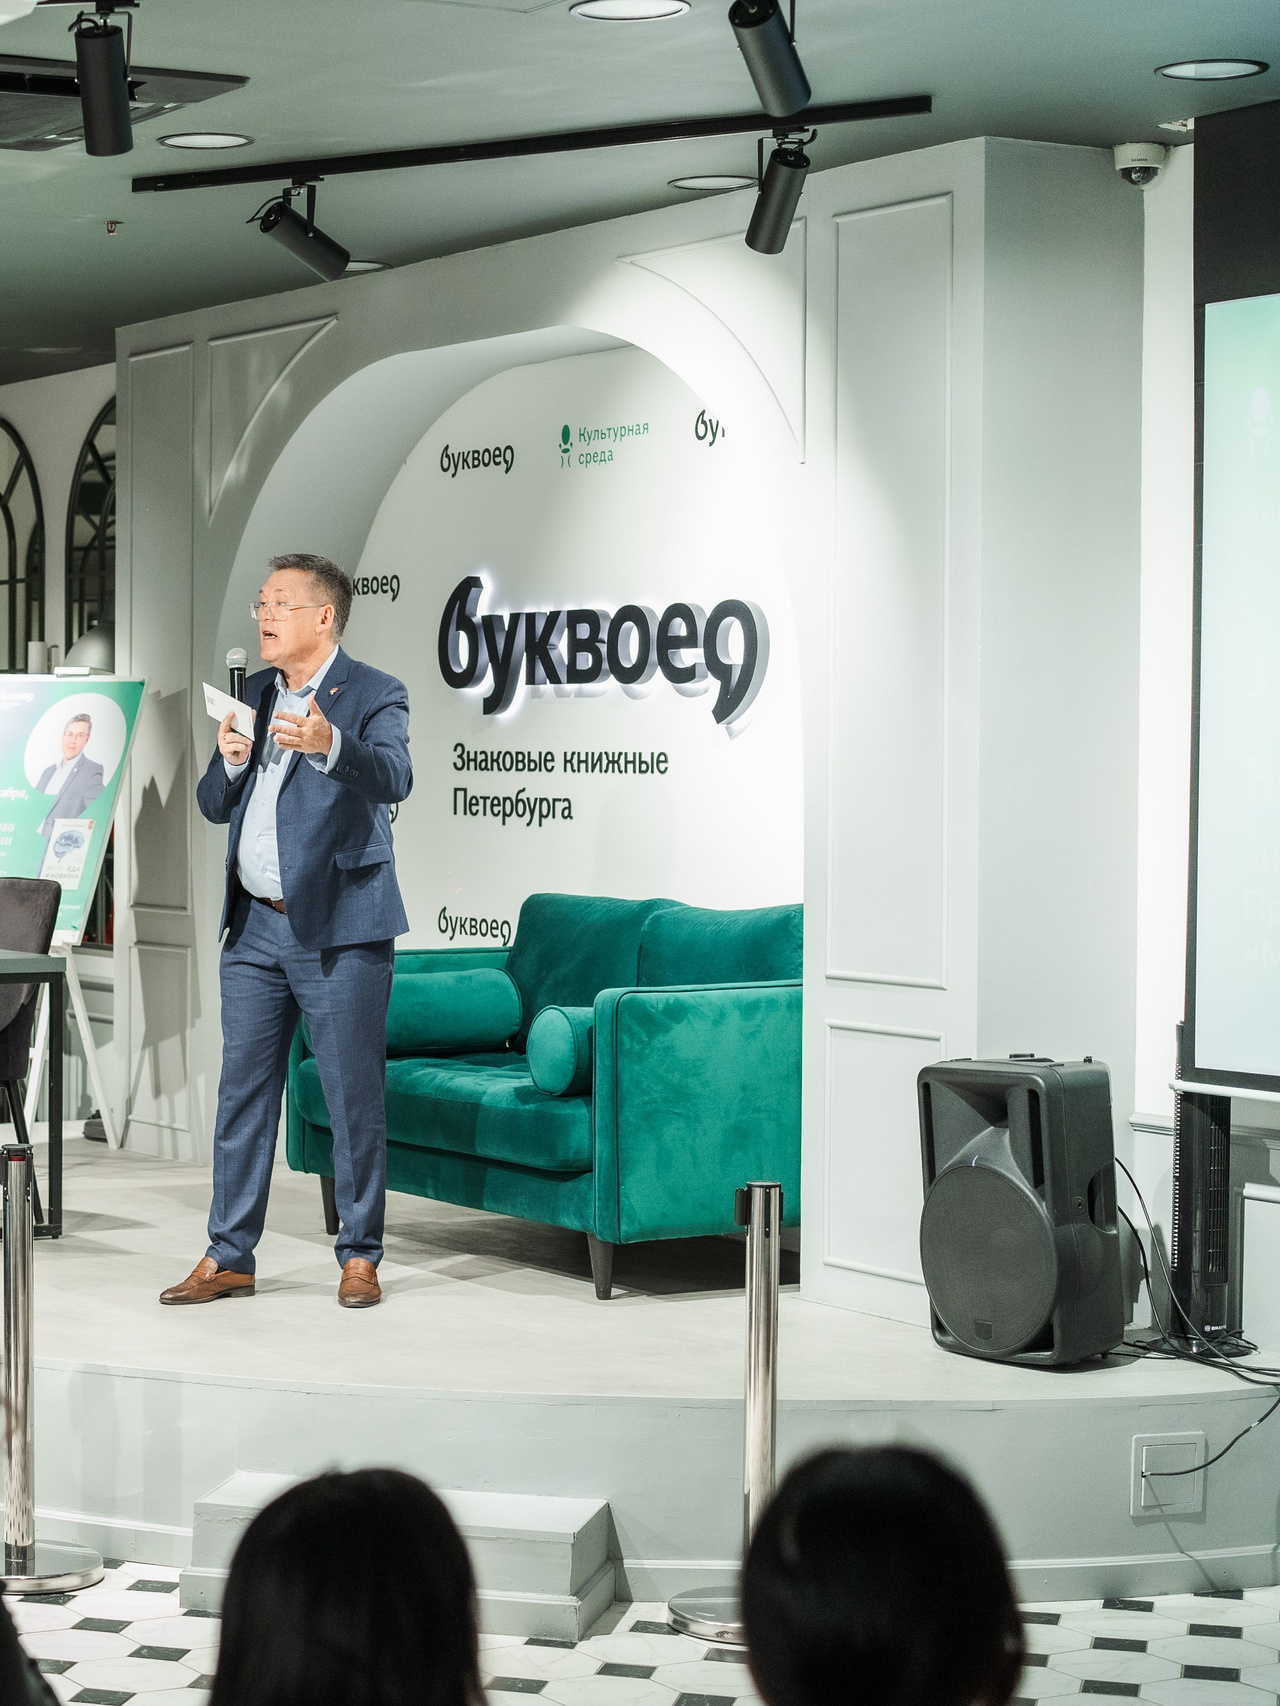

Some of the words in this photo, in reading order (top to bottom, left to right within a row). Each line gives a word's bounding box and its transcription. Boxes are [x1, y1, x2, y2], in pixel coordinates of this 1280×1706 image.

[578, 422, 650, 447] Культурная
[440, 444, 515, 478] буквоед
[578, 450, 614, 468] среда
[352, 574, 400, 602] квоед
[437, 575, 766, 727] буквоед
[453, 743, 556, 772] Знаковые
[563, 750, 669, 775] книжные
[453, 787, 574, 827] Петербурга
[438, 906, 511, 946] буквоед
